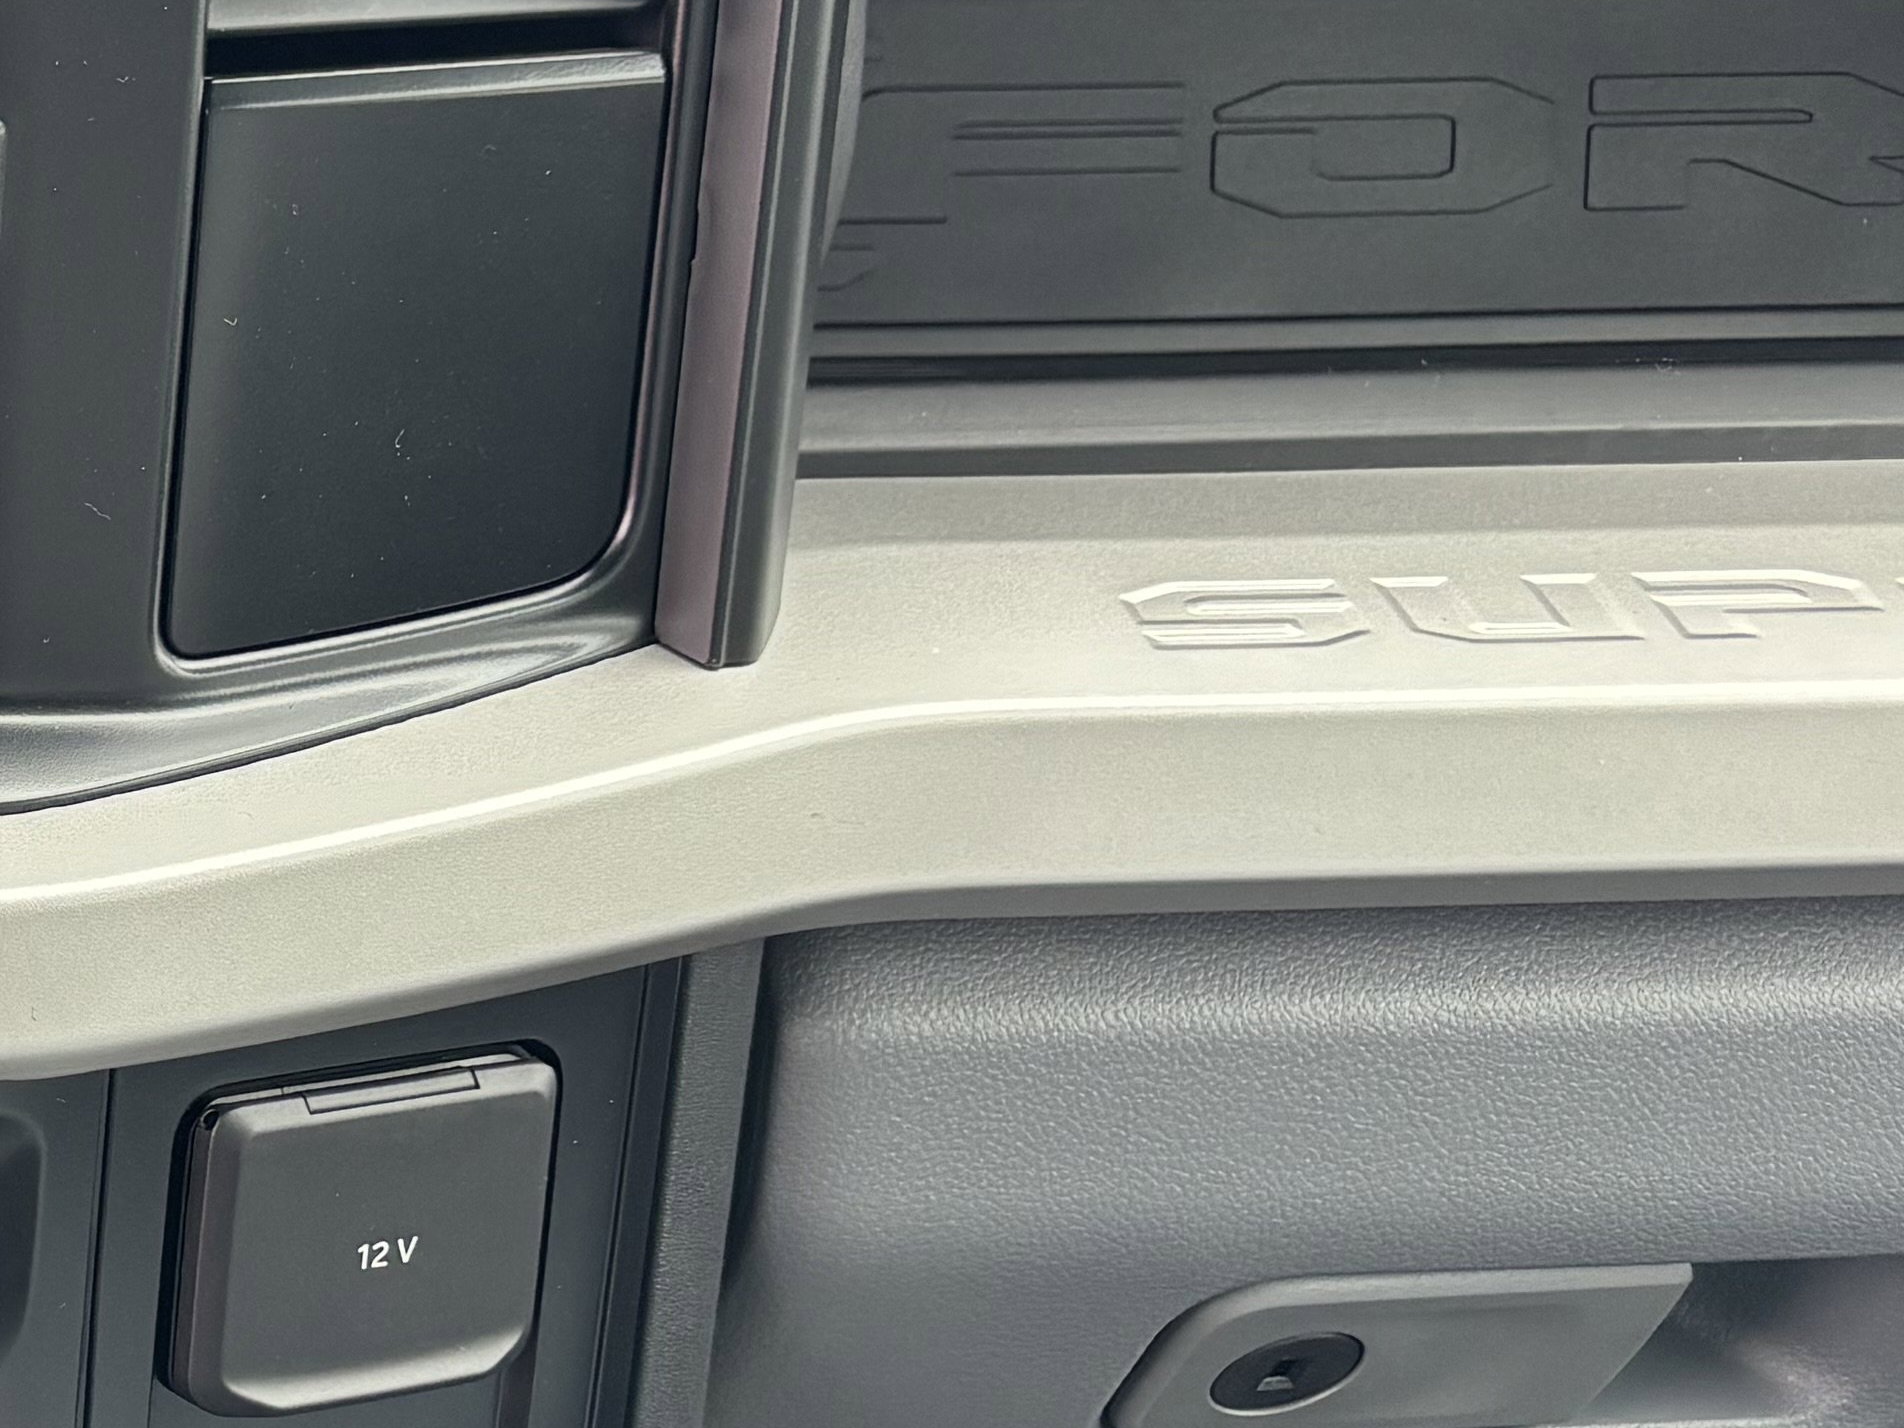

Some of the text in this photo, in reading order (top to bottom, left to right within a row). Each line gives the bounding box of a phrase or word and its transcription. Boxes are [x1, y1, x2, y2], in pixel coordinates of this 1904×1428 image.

[1119, 566, 1904, 648] SUP
[357, 1236, 419, 1270] 12 V
